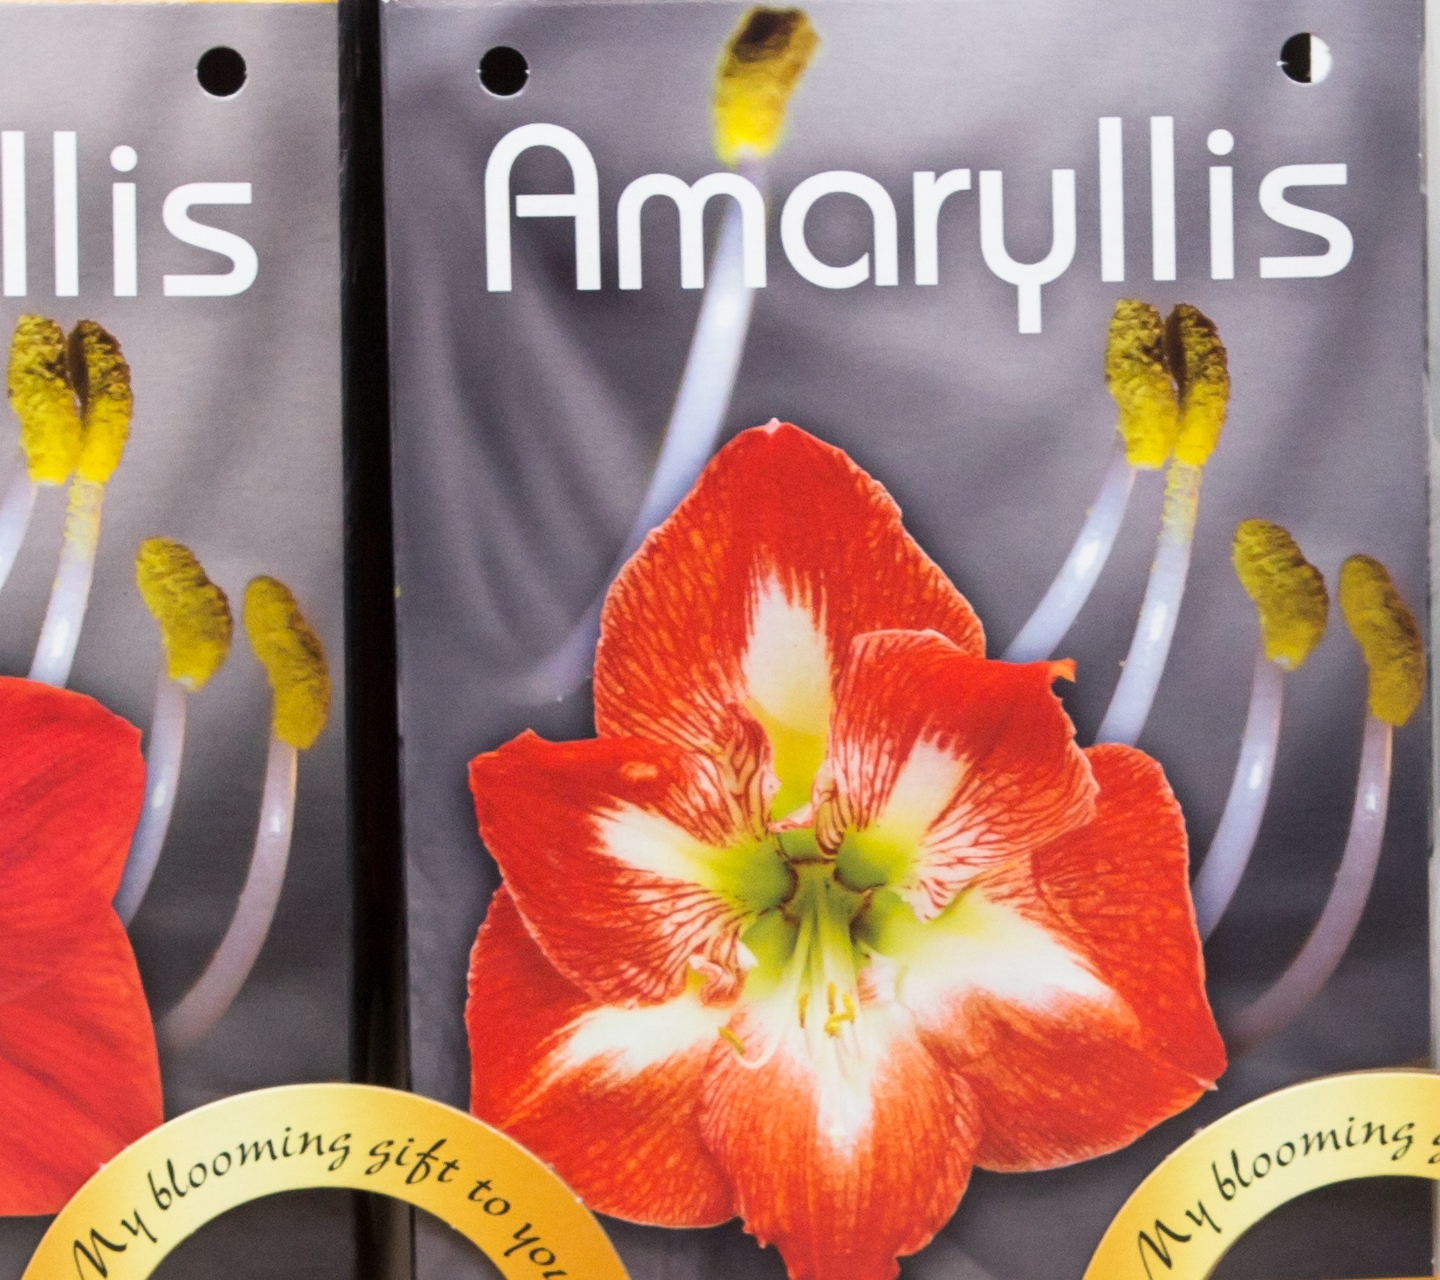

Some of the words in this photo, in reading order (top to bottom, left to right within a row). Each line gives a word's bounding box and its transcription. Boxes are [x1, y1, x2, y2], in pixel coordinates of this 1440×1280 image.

[484, 115, 1355, 335] Amaryllis
[148, 1127, 353, 1210] blooming
[368, 1138, 460, 1184] gift
[467, 1179, 510, 1217] to
[1212, 1117, 1415, 1203] blooming
